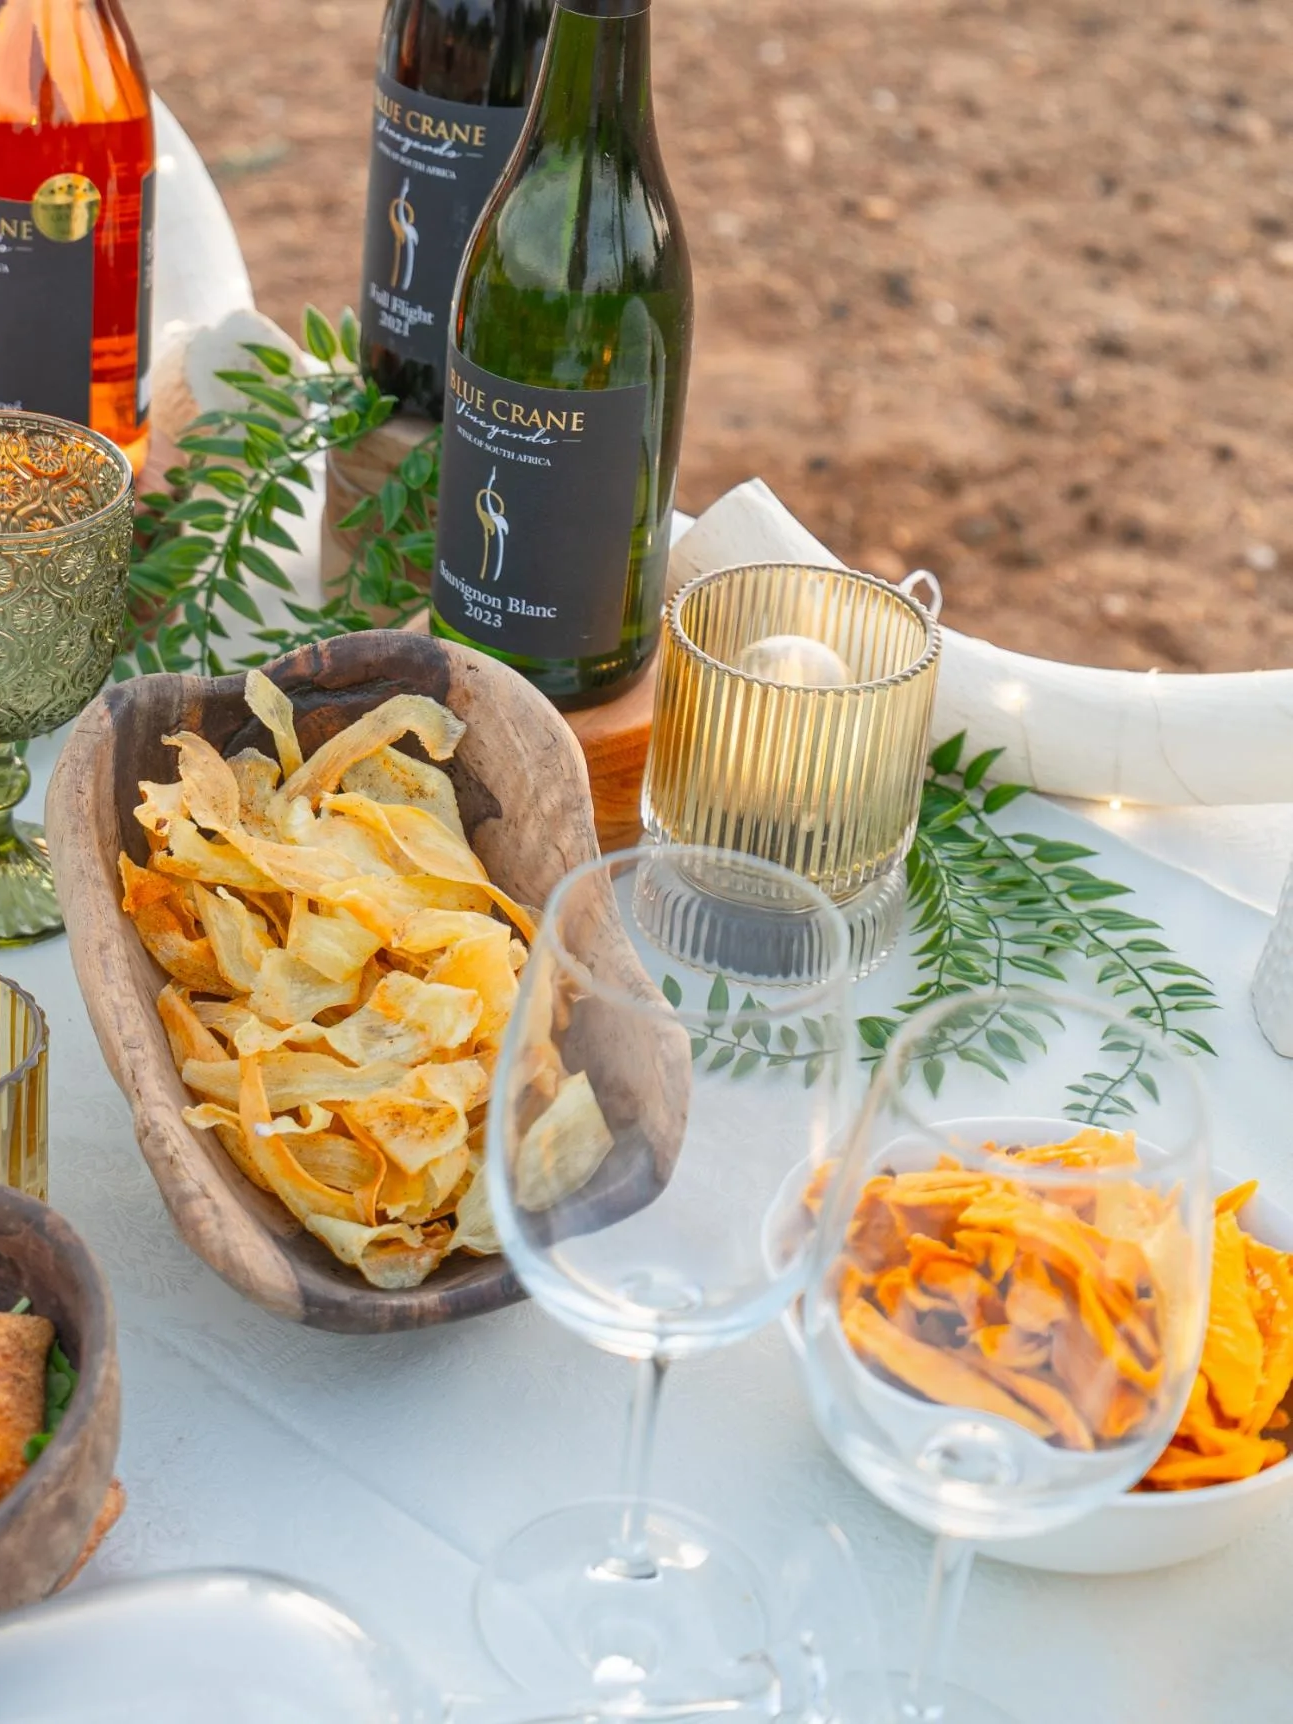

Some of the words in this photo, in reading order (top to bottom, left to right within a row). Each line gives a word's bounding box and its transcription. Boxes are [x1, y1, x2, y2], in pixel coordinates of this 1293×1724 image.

[405, 111, 486, 146] CRANE
[390, 296, 435, 325] Flight
[450, 367, 486, 412] BLUE
[492, 399, 585, 432] CRANE
[455, 397, 558, 445] Vineyards
[472, 436, 485, 449] OF
[484, 442, 515, 460] SOUTH
[516, 453, 552, 467] AFRICA
[439, 560, 503, 610] Sauvignon
[507, 596, 558, 618] Blanc
[464, 602, 503, 628] 2023
